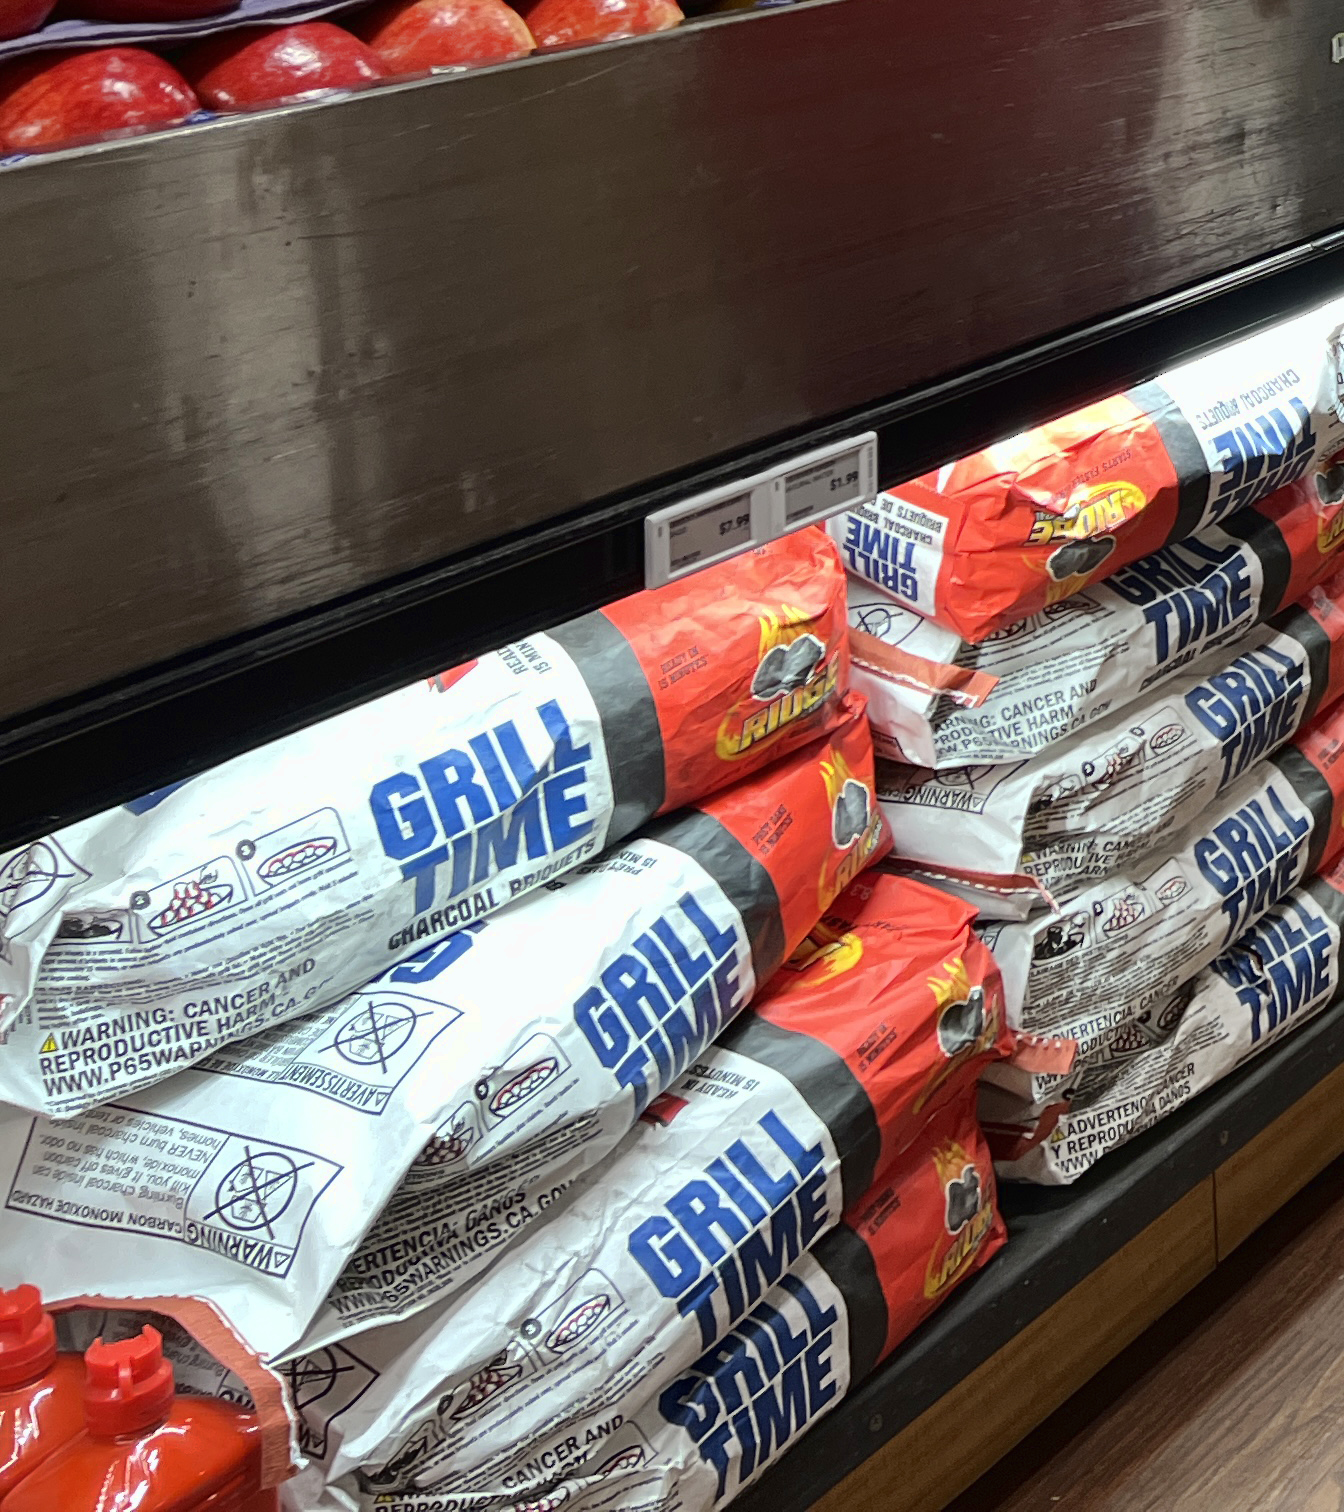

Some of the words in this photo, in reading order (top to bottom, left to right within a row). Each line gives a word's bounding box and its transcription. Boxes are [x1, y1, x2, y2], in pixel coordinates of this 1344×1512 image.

[1213, 396, 1316, 497] TIME
[830, 470, 859, 491] $1.99
[880, 498, 895, 511] DE
[719, 513, 750, 535] $7.99
[876, 514, 933, 544] CHARCOAL
[897, 504, 944, 534] BRIQUETS
[847, 518, 918, 574] TIME
[842, 543, 919, 603] GRILL
[1142, 553, 1252, 666] TIME
[1001, 690, 1066, 721] CANCER
[1069, 678, 1098, 700] AND
[1027, 705, 1073, 732] HARM
[1184, 644, 1305, 743] GRILL
[1219, 694, 1301, 795] TIME
[368, 698, 593, 861] GRILL
[903, 786, 974, 811] WARNING
[399, 765, 597, 917] TIME
[1194, 785, 1310, 898] GRILL
[387, 888, 500, 951] CHARCOAL
[509, 835, 597, 899] BRIQUETS
[60, 1007, 176, 1051] WARNING:
[182, 981, 271, 1020] CANCER
[276, 957, 317, 988] AND
[573, 890, 739, 1071] GRILL
[1235, 931, 1332, 1044] TIME
[37, 1020, 210, 1076] REPRODUCTIVE
[216, 995, 278, 1033] HARM
[614, 948, 741, 1124] TIME
[702, 1081, 740, 1099] READY
[87, 1124, 138, 1145] charcoal
[105, 1149, 139, 1167] which
[140, 1136, 166, 1153] burn
[169, 1143, 212, 1163] NEVER
[179, 1129, 223, 1150] homes,
[1051, 1144, 1061, 1160] Y
[11, 1190, 54, 1210] HAZARD
[55, 1199, 125, 1225] MONOXIDE
[85, 1176, 135, 1198] charcoal
[627, 1107, 826, 1299] GRILL
[128, 1212, 183, 1235] CARBON
[186, 1220, 272, 1270] WARNING
[676, 1165, 830, 1356] TIME
[658, 1272, 838, 1443] GRILL
[698, 1329, 838, 1508] TIME
[502, 1436, 581, 1489] CANCER
[584, 1413, 625, 1445] AND
